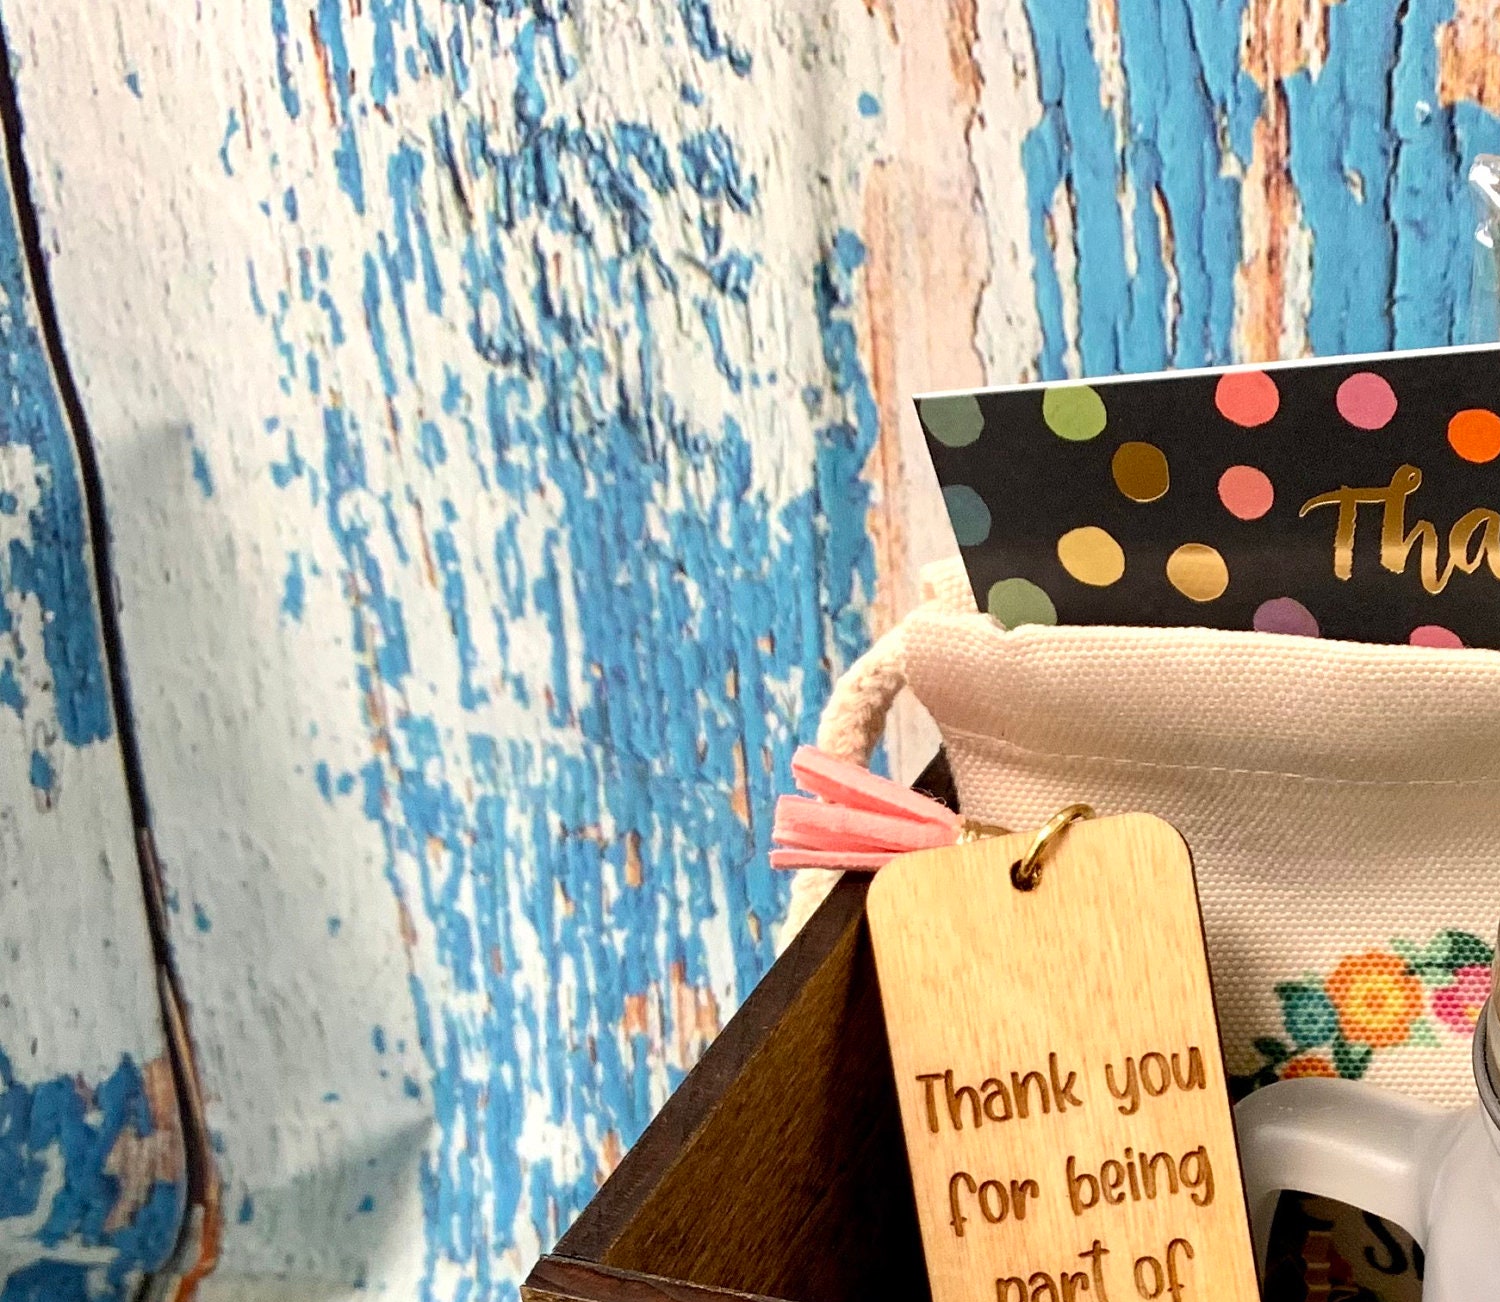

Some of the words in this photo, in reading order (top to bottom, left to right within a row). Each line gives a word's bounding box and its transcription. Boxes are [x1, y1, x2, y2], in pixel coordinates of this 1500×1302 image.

[915, 1052, 1083, 1134] Thank
[1105, 1045, 1208, 1116] you
[948, 1170, 1040, 1238] for
[1066, 1144, 1215, 1216] being
